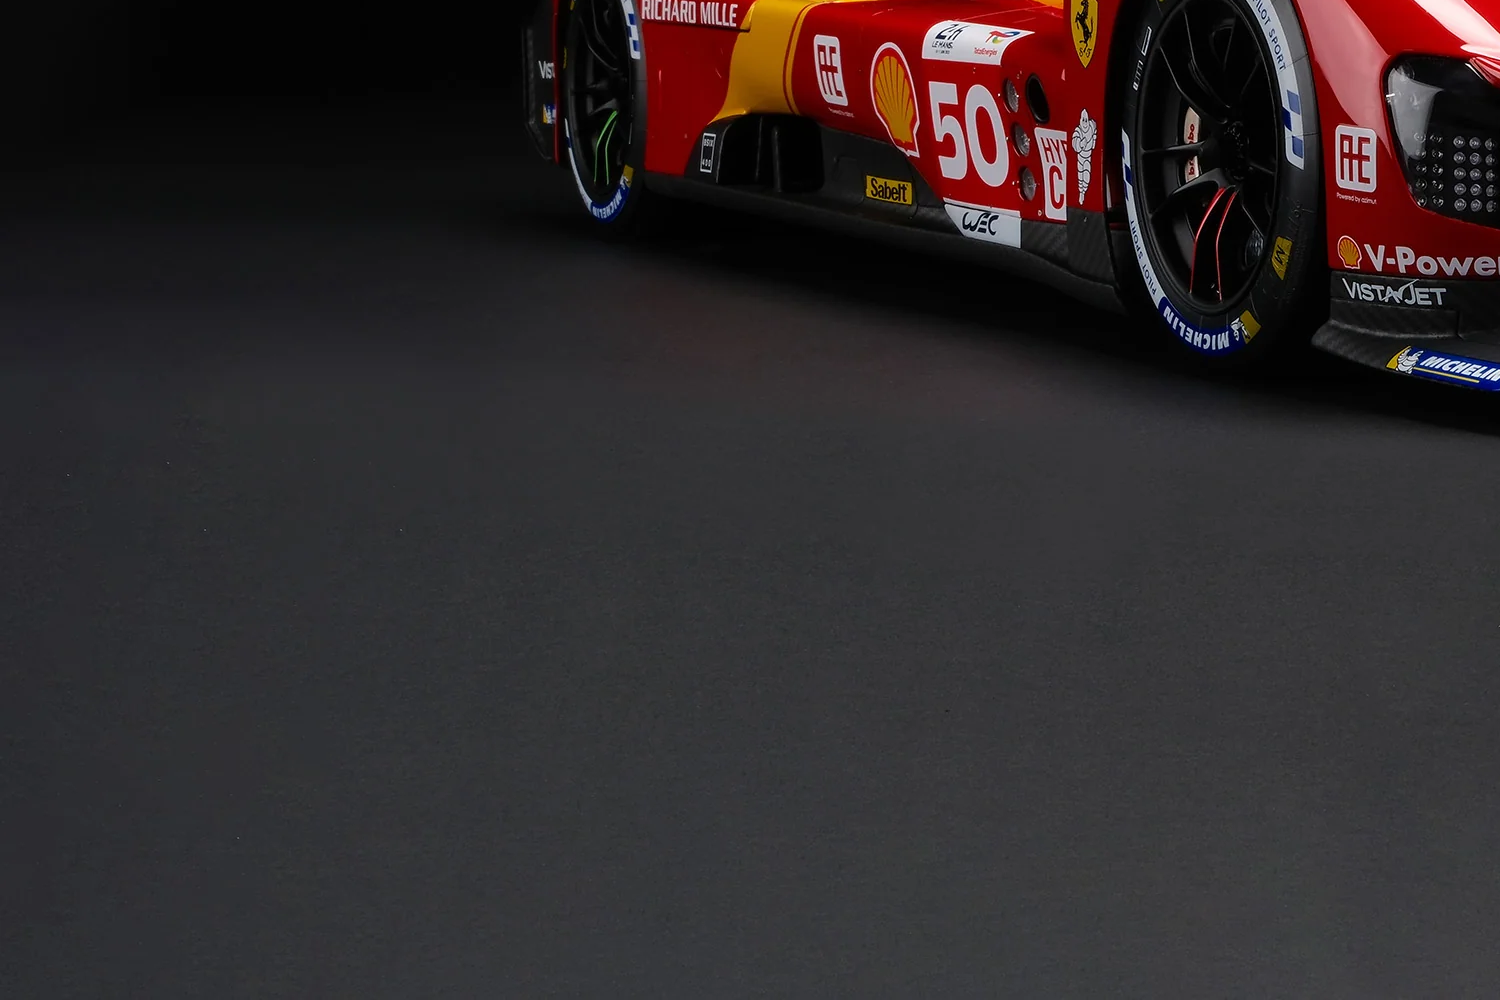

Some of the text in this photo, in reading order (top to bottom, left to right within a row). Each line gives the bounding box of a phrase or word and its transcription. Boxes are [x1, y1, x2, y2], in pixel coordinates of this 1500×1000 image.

[700, 1, 738, 27] MILLE
[1268, 28, 1287, 72] SPORT
[929, 80, 1009, 187] 50
[870, 178, 908, 203] Sabelt
[1163, 305, 1230, 351] MICHELIN
